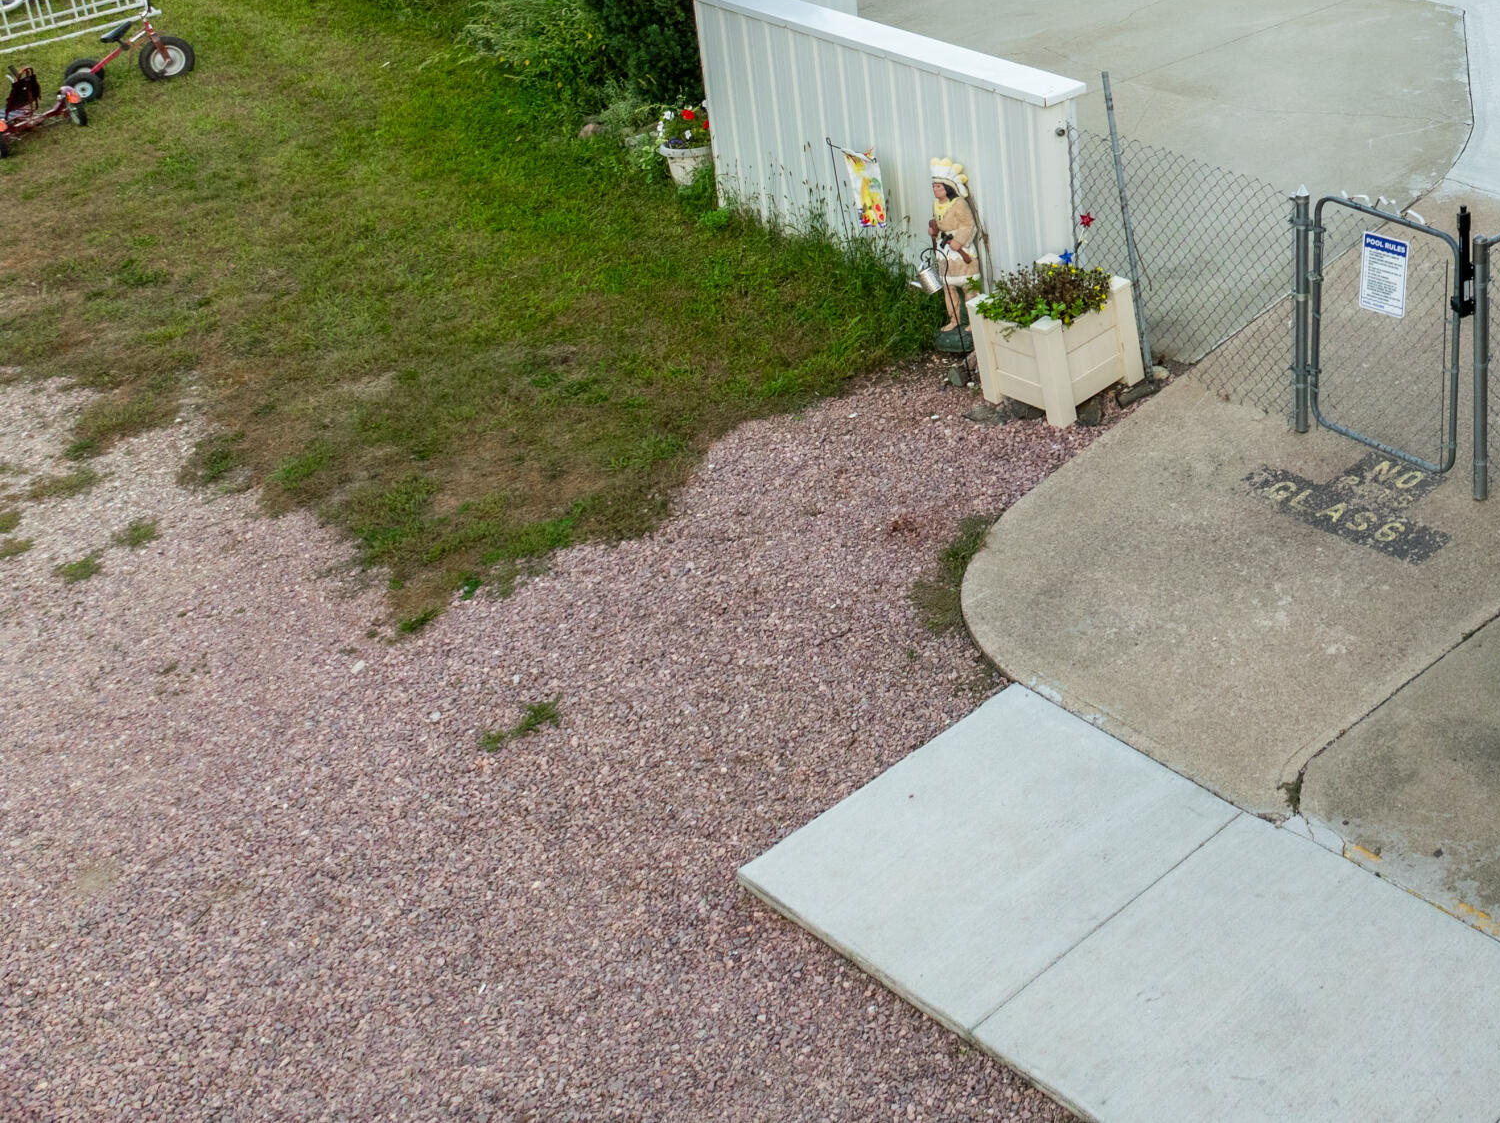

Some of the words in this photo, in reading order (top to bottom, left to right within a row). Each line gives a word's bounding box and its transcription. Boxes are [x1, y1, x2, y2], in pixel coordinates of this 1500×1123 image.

[1366, 238, 1384, 248] POOL
[1384, 242, 1406, 253] RULES
[1368, 460, 1425, 489] NO
